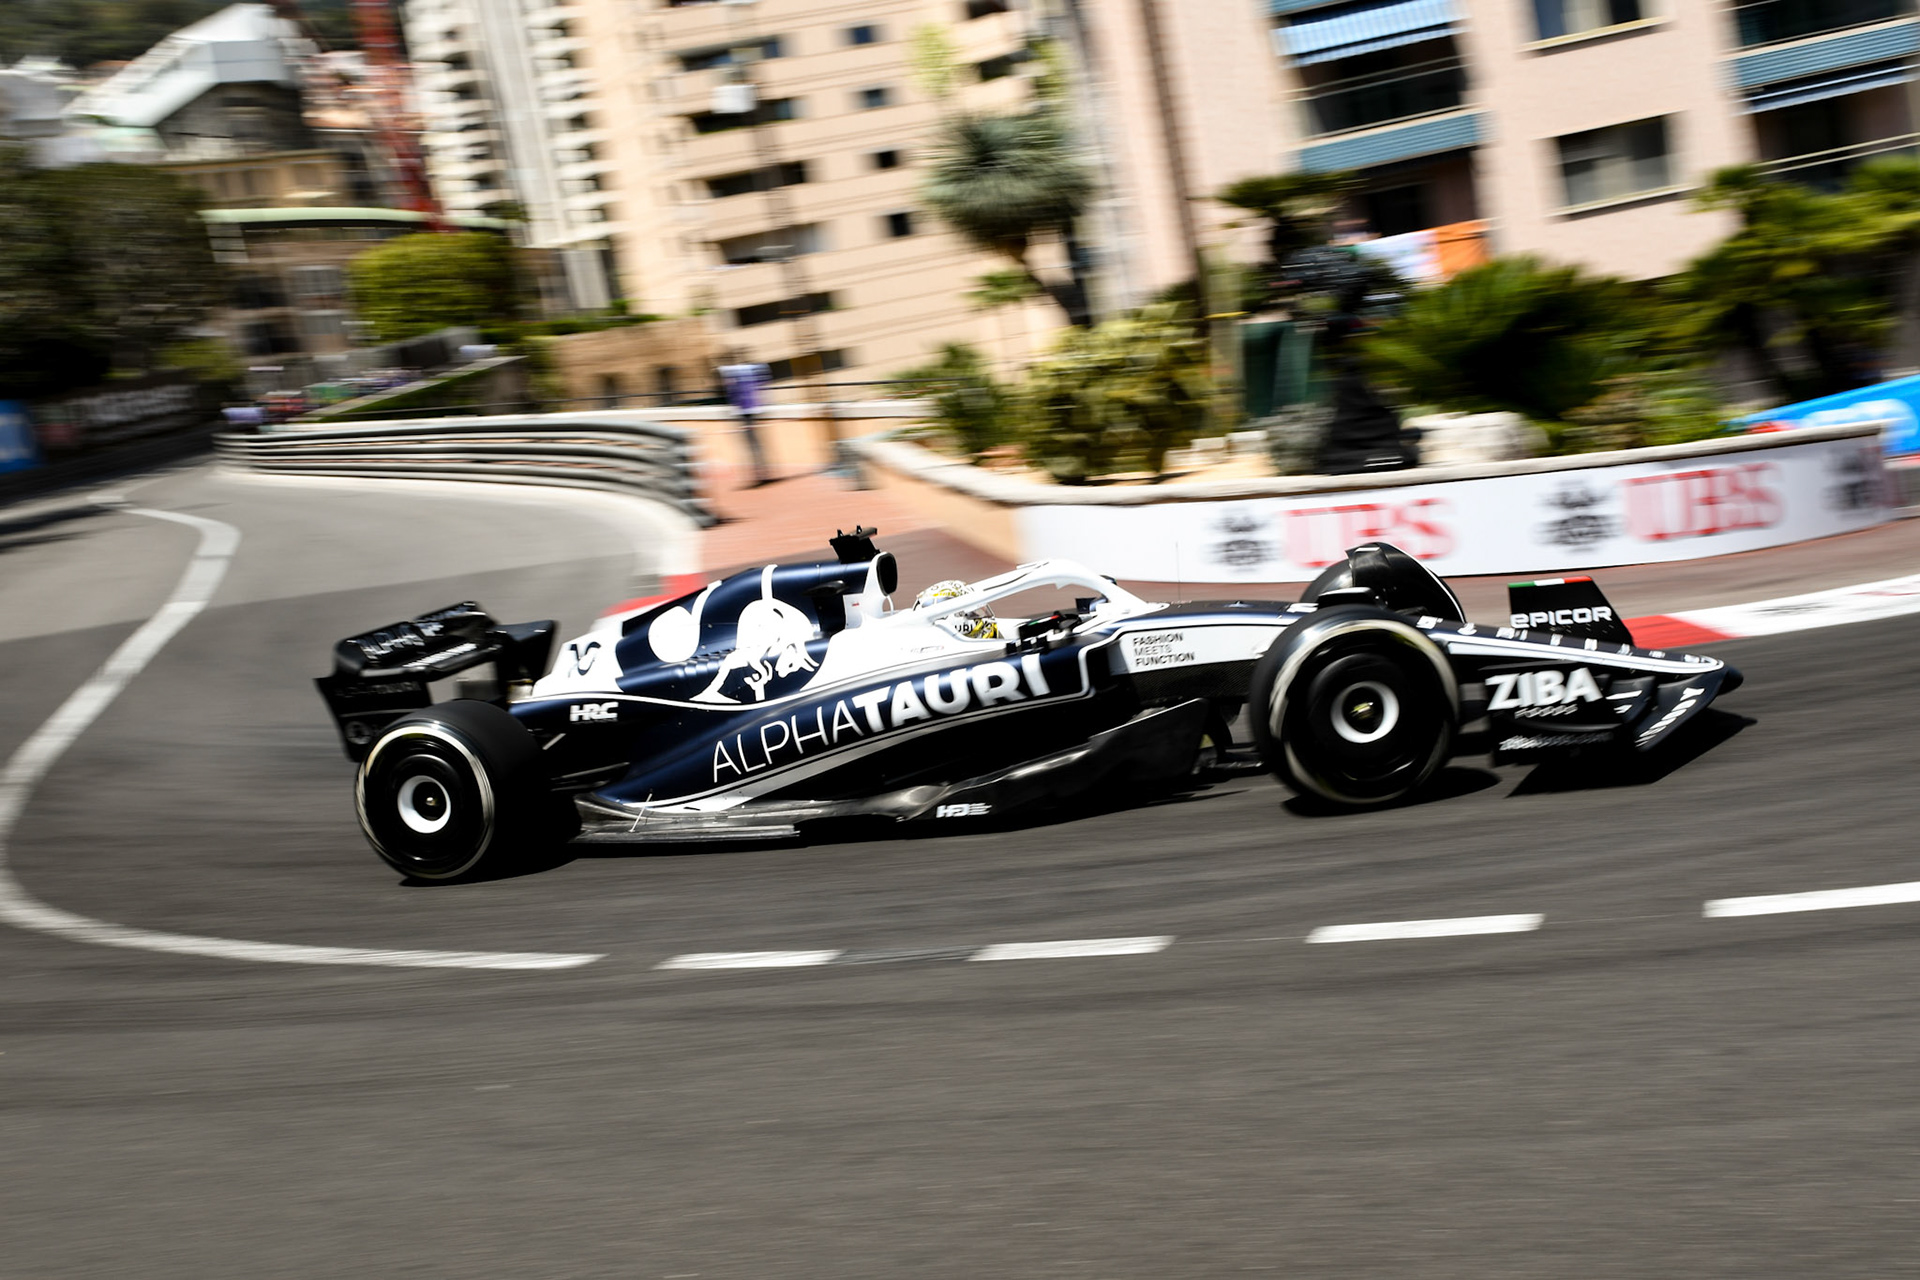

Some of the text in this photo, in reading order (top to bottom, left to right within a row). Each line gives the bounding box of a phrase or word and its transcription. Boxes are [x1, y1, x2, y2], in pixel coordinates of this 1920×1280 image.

[1133, 632, 1183, 646] FASHION
[1134, 644, 1172, 656] MEETS
[1136, 651, 1195, 666] FUNCTION
[1485, 667, 1603, 711] ZIBA
[569, 701, 619, 722] HRC
[713, 653, 1051, 784] ALPHATAURI
